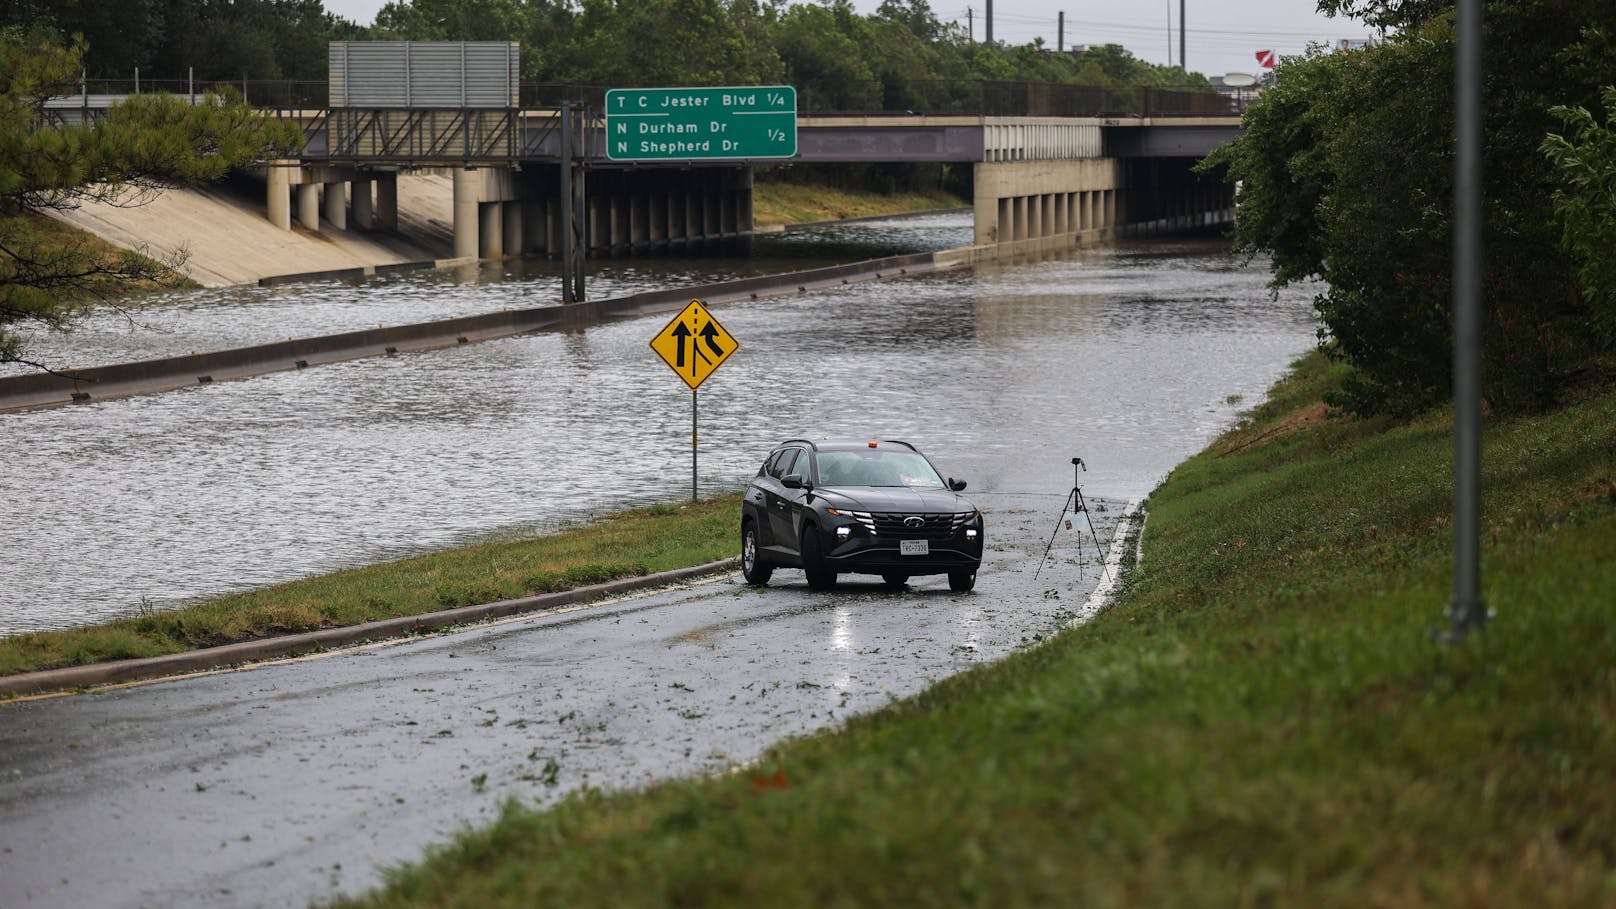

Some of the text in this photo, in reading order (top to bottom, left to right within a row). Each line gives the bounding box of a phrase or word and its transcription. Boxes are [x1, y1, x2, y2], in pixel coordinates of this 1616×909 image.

[617, 96, 625, 107] T
[638, 96, 647, 107] C
[661, 96, 709, 107] Jester
[722, 94, 756, 106] Blvd
[617, 121, 727, 134] N Durham Dr
[618, 140, 739, 155] N Shepherd Dr
